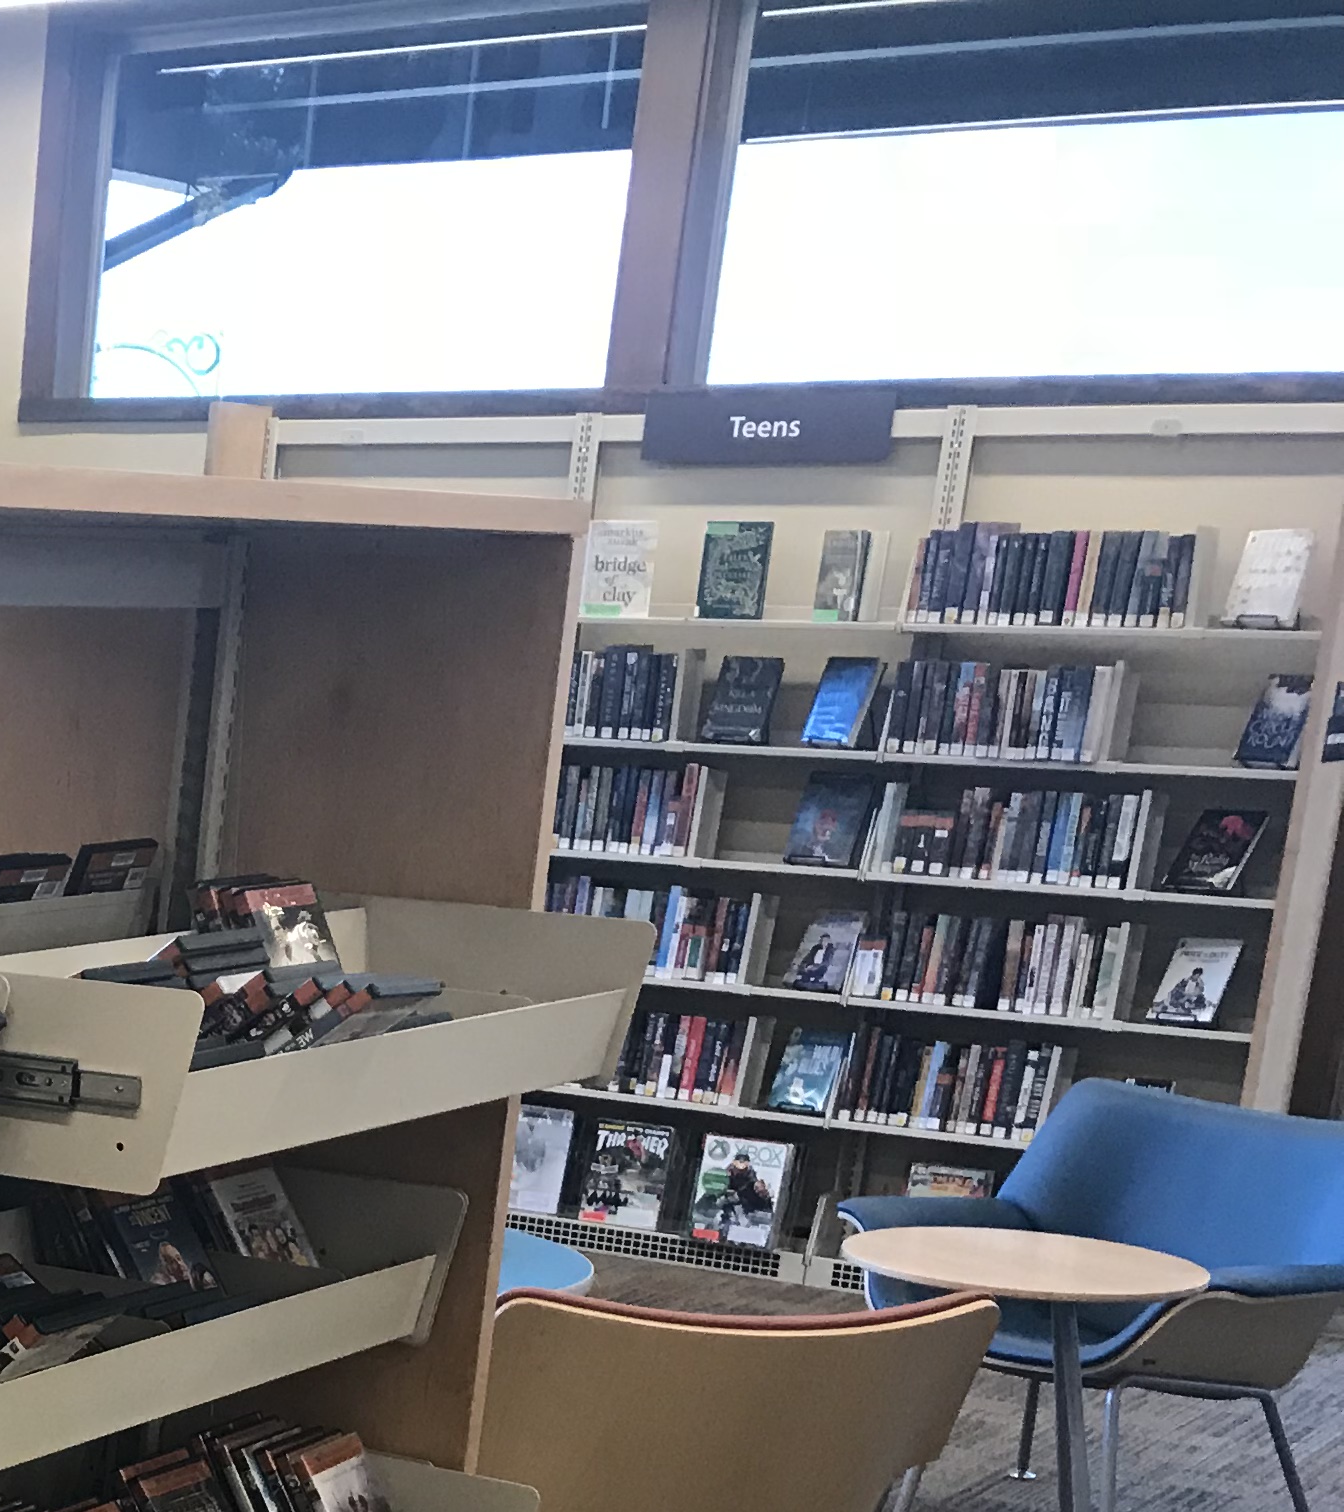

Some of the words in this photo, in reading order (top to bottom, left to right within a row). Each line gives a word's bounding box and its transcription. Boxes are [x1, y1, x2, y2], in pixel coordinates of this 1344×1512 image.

[729, 416, 801, 438] Teens
[594, 554, 647, 574] bridge
[602, 586, 636, 607] clay
